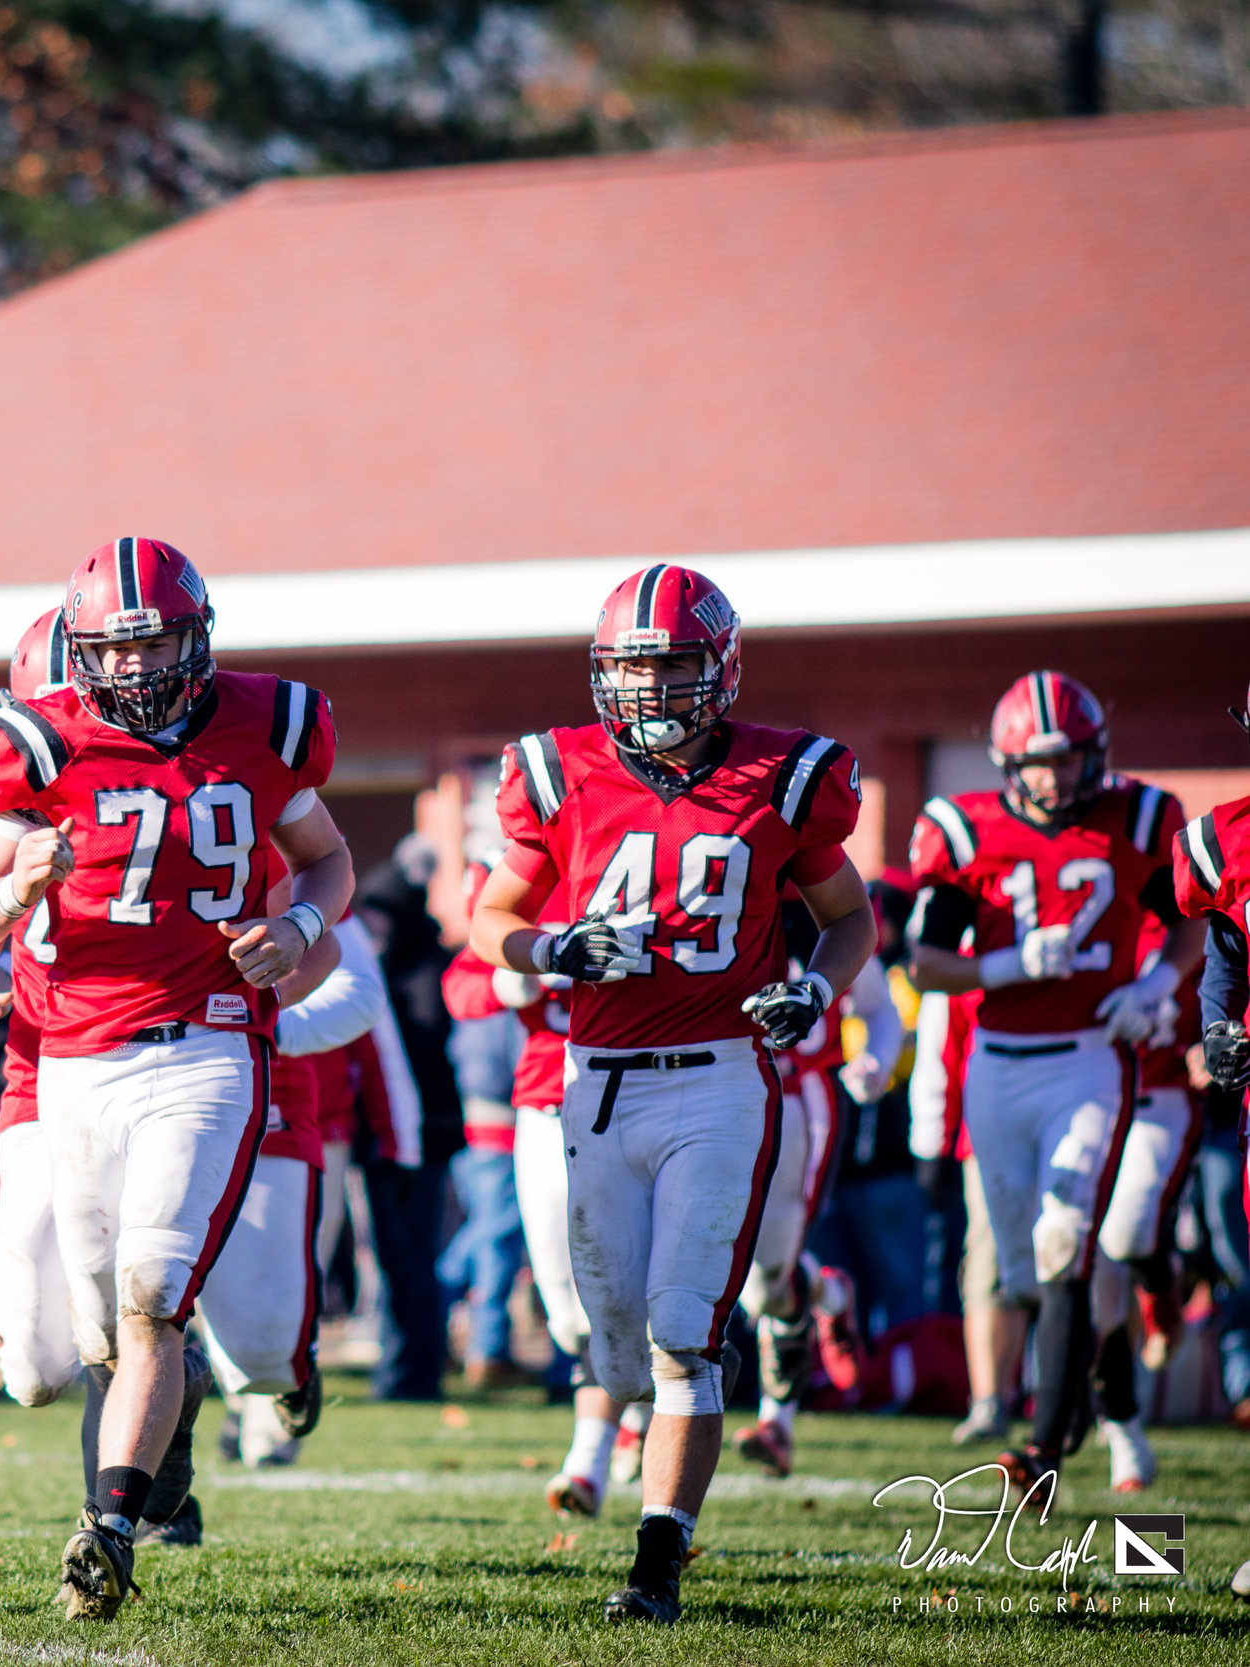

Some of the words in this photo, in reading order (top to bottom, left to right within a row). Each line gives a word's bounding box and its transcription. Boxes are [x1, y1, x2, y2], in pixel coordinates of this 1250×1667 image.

[118, 611, 148, 623] Riddell
[94, 781, 256, 926] 79
[585, 831, 752, 976] 49
[1000, 857, 1116, 972] 12
[213, 999, 244, 1009] Riddell
